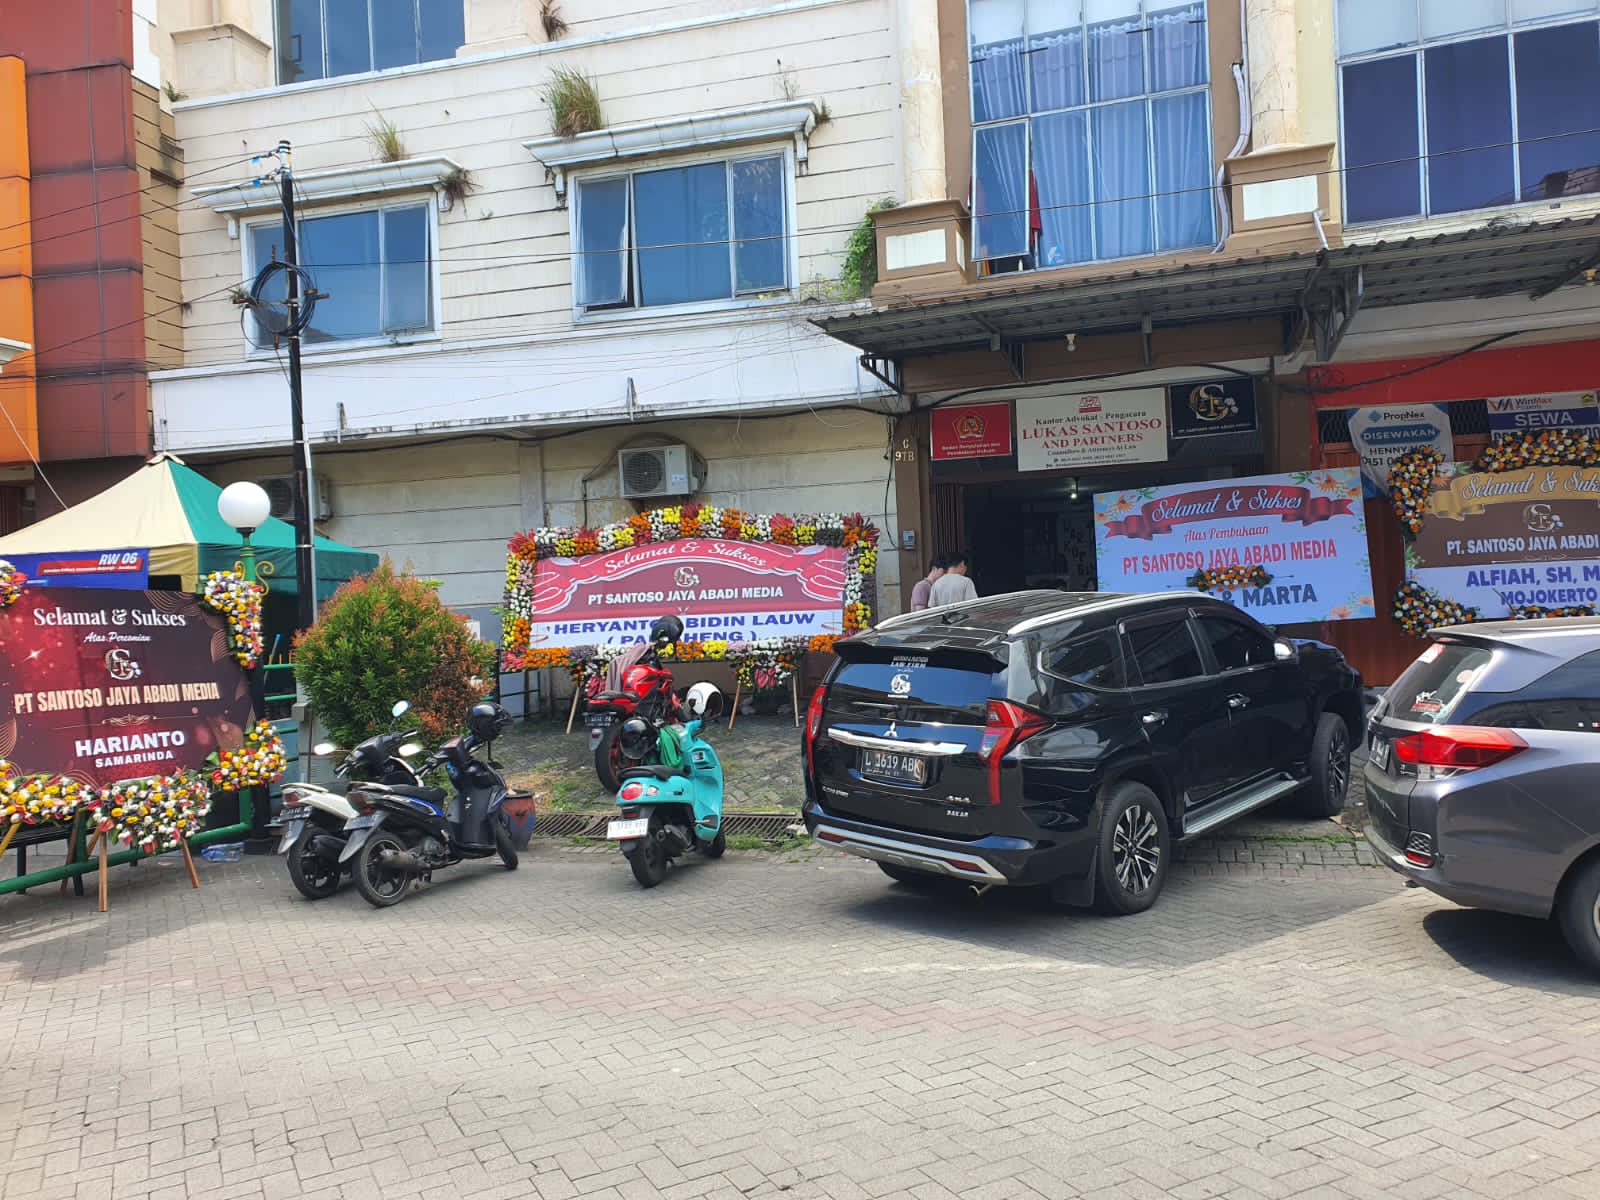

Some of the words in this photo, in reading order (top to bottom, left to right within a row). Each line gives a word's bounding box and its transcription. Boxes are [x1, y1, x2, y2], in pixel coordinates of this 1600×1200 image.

[1035, 417, 1064, 425] Kantor
[1065, 414, 1099, 424] Advokat
[1105, 411, 1147, 421] Pengacara
[1383, 411, 1425, 421] PropNex
[1514, 411, 1574, 427] SEWA
[1022, 425, 1078, 440] LUKAS
[1082, 418, 1162, 434] SANTOSO
[1363, 429, 1436, 440] DISEWAKAN
[1042, 439, 1069, 449] AND
[1073, 433, 1144, 446] PARTNERS
[1370, 446, 1407, 456] HENNY
[1462, 472, 1535, 499] Selamat
[1540, 471, 1557, 493] &
[1152, 493, 1220, 522] Selamat
[1226, 489, 1244, 512] &
[1249, 488, 1303, 511] Sukses
[1184, 529, 1207, 544] Atas
[1208, 525, 1270, 541] Pembukaan
[1446, 541, 1465, 556] PT.
[1467, 537, 1526, 555] SANTOSO
[1528, 536, 1558, 552] JAYA
[1559, 534, 1600, 550] ABADI
[98, 553, 120, 565] RW
[604, 543, 676, 574] Selamat
[681, 541, 702, 553] &
[708, 543, 767, 567] Sukses
[1122, 556, 1139, 576] PT
[1142, 551, 1205, 574] SANTOSO
[1208, 546, 1240, 568] JAYA
[1243, 543, 1287, 565] ABADI
[1291, 538, 1337, 561] MEDIA
[1466, 567, 1541, 587] ALFIAH,
[1546, 566, 1577, 584] SH,
[588, 594, 603, 605] PT
[605, 591, 664, 604] SANTOSO
[667, 590, 696, 601] JAYA
[699, 588, 739, 599] ABADI
[742, 586, 784, 598] MEDIA
[1242, 583, 1318, 607] MARTA
[1500, 588, 1598, 605] MOJOKERTO
[33, 608, 107, 626] Selamat
[111, 608, 127, 626] &
[132, 609, 186, 627] Sukses
[752, 613, 815, 627] LAUW
[83, 632, 107, 643] Atas
[14, 693, 33, 714] PT
[37, 688, 102, 712] SANTOSO
[106, 686, 141, 706] JAYA
[143, 684, 180, 704] ABADI
[182, 682, 220, 700] MEDIA
[75, 730, 186, 757] HARIANTO
[95, 749, 174, 768] SAMARINDA
[865, 751, 871, 766] L
[875, 752, 898, 769] 1619
